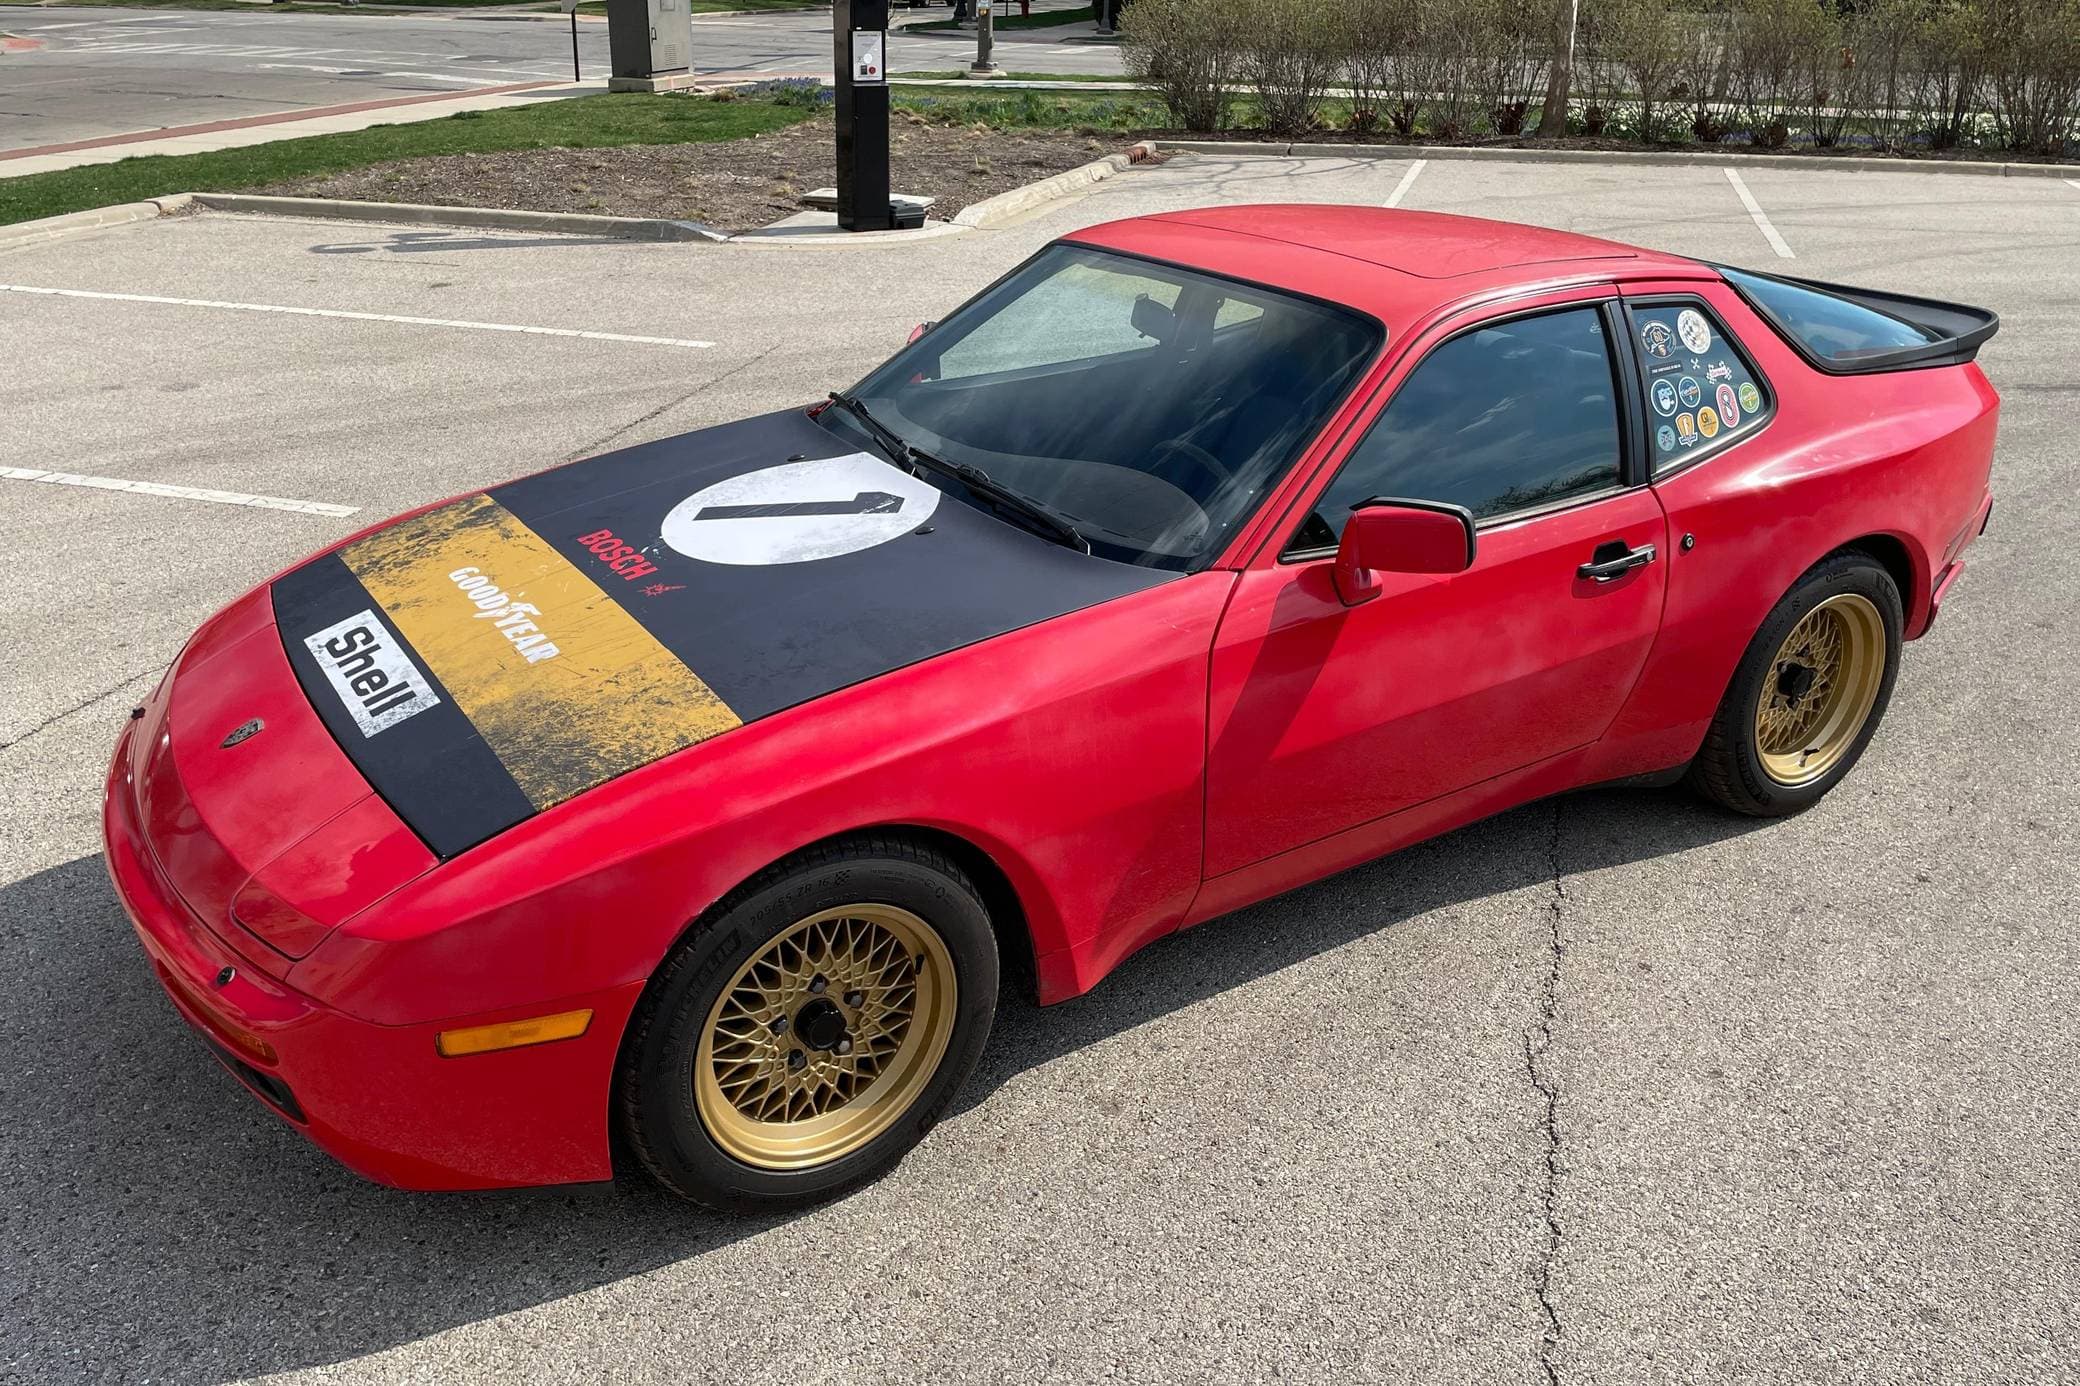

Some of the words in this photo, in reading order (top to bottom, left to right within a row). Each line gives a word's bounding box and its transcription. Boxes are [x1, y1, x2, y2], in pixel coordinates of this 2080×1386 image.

[694, 491, 905, 520] 1
[576, 529, 658, 581] BOSCH
[448, 566, 560, 664] GOODYEAR
[324, 626, 417, 718] Shell
